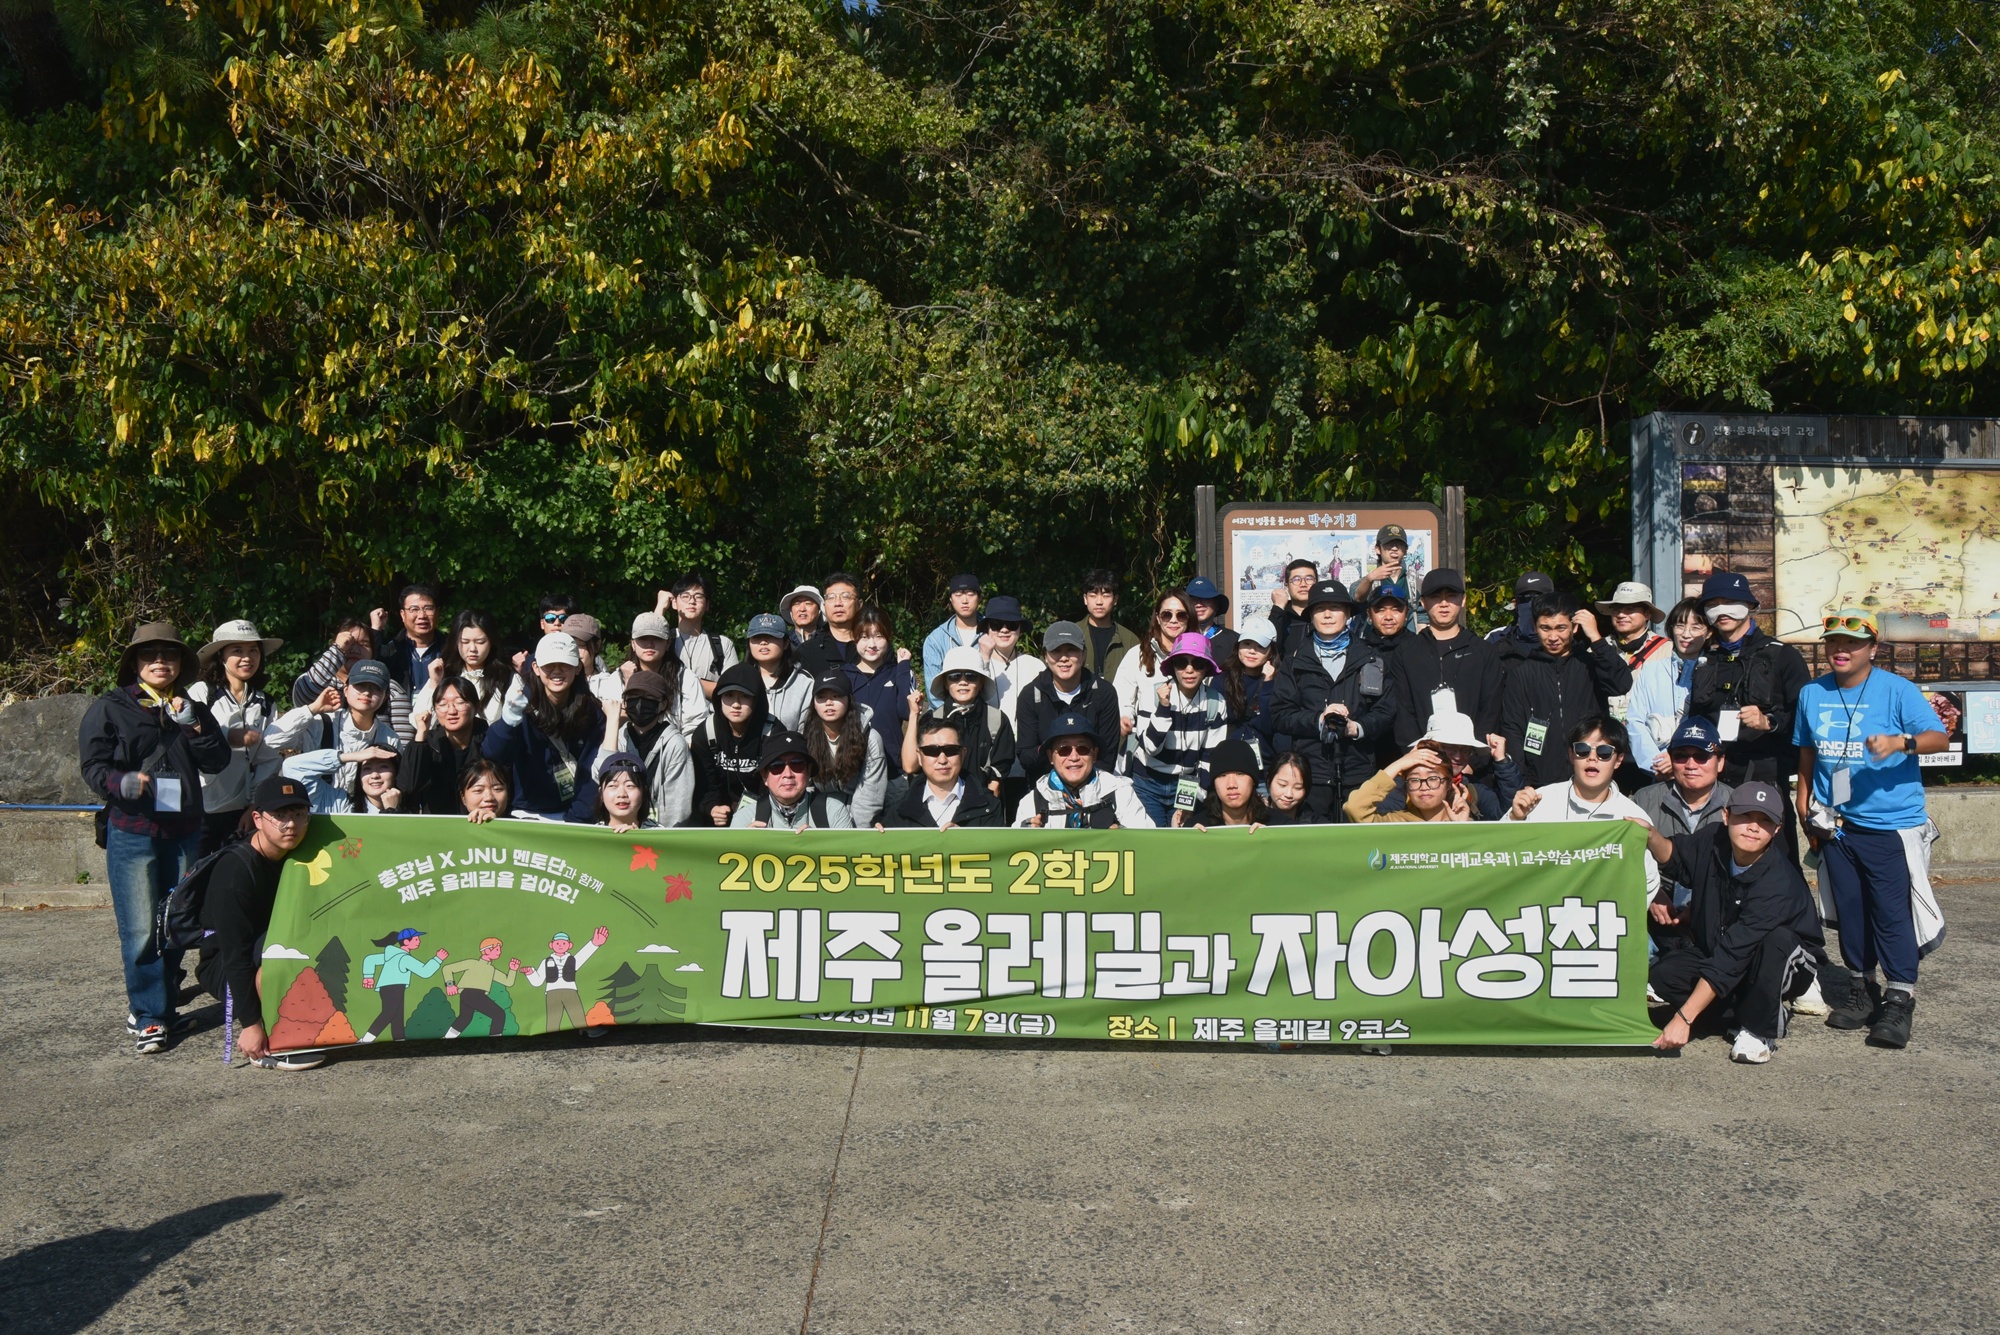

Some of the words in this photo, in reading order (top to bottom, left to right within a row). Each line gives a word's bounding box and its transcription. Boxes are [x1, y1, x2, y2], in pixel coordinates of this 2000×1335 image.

[1795, 426, 1816, 437] 고장
[1308, 513, 1357, 528] 박수기정
[1814, 740, 1864, 751] UNDER
[1818, 749, 1864, 758] ARMOUR
[1756, 790, 1767, 802] C
[1389, 853, 1439, 865] 제주대학교
[1440, 852, 1511, 868] 미래교육과
[1520, 843, 1623, 866] 교수학습지원센터
[377, 855, 435, 889] 총장님
[438, 850, 456, 869] X
[460, 847, 507, 865] JNU
[513, 849, 577, 880] 멘토단과
[578, 872, 604, 894] 함께
[718, 853, 993, 894] 2025학년도
[1008, 850, 1136, 896] 2학기
[397, 878, 436, 904] 제주
[441, 871, 515, 892] 올레길을
[520, 873, 580, 904] 걸어요!
[720, 908, 903, 1003] 제주
[921, 908, 1237, 1004] 올레길과
[1246, 896, 1628, 1000] 자아성찰
[904, 1004, 956, 1031] 11월
[963, 1008, 1057, 1036] 7일(금)
[1107, 1015, 1160, 1040] 장소
[1192, 1017, 1245, 1041] 제주
[1252, 1017, 1332, 1042] 올레길
[1338, 1018, 1411, 1041] 9코스
